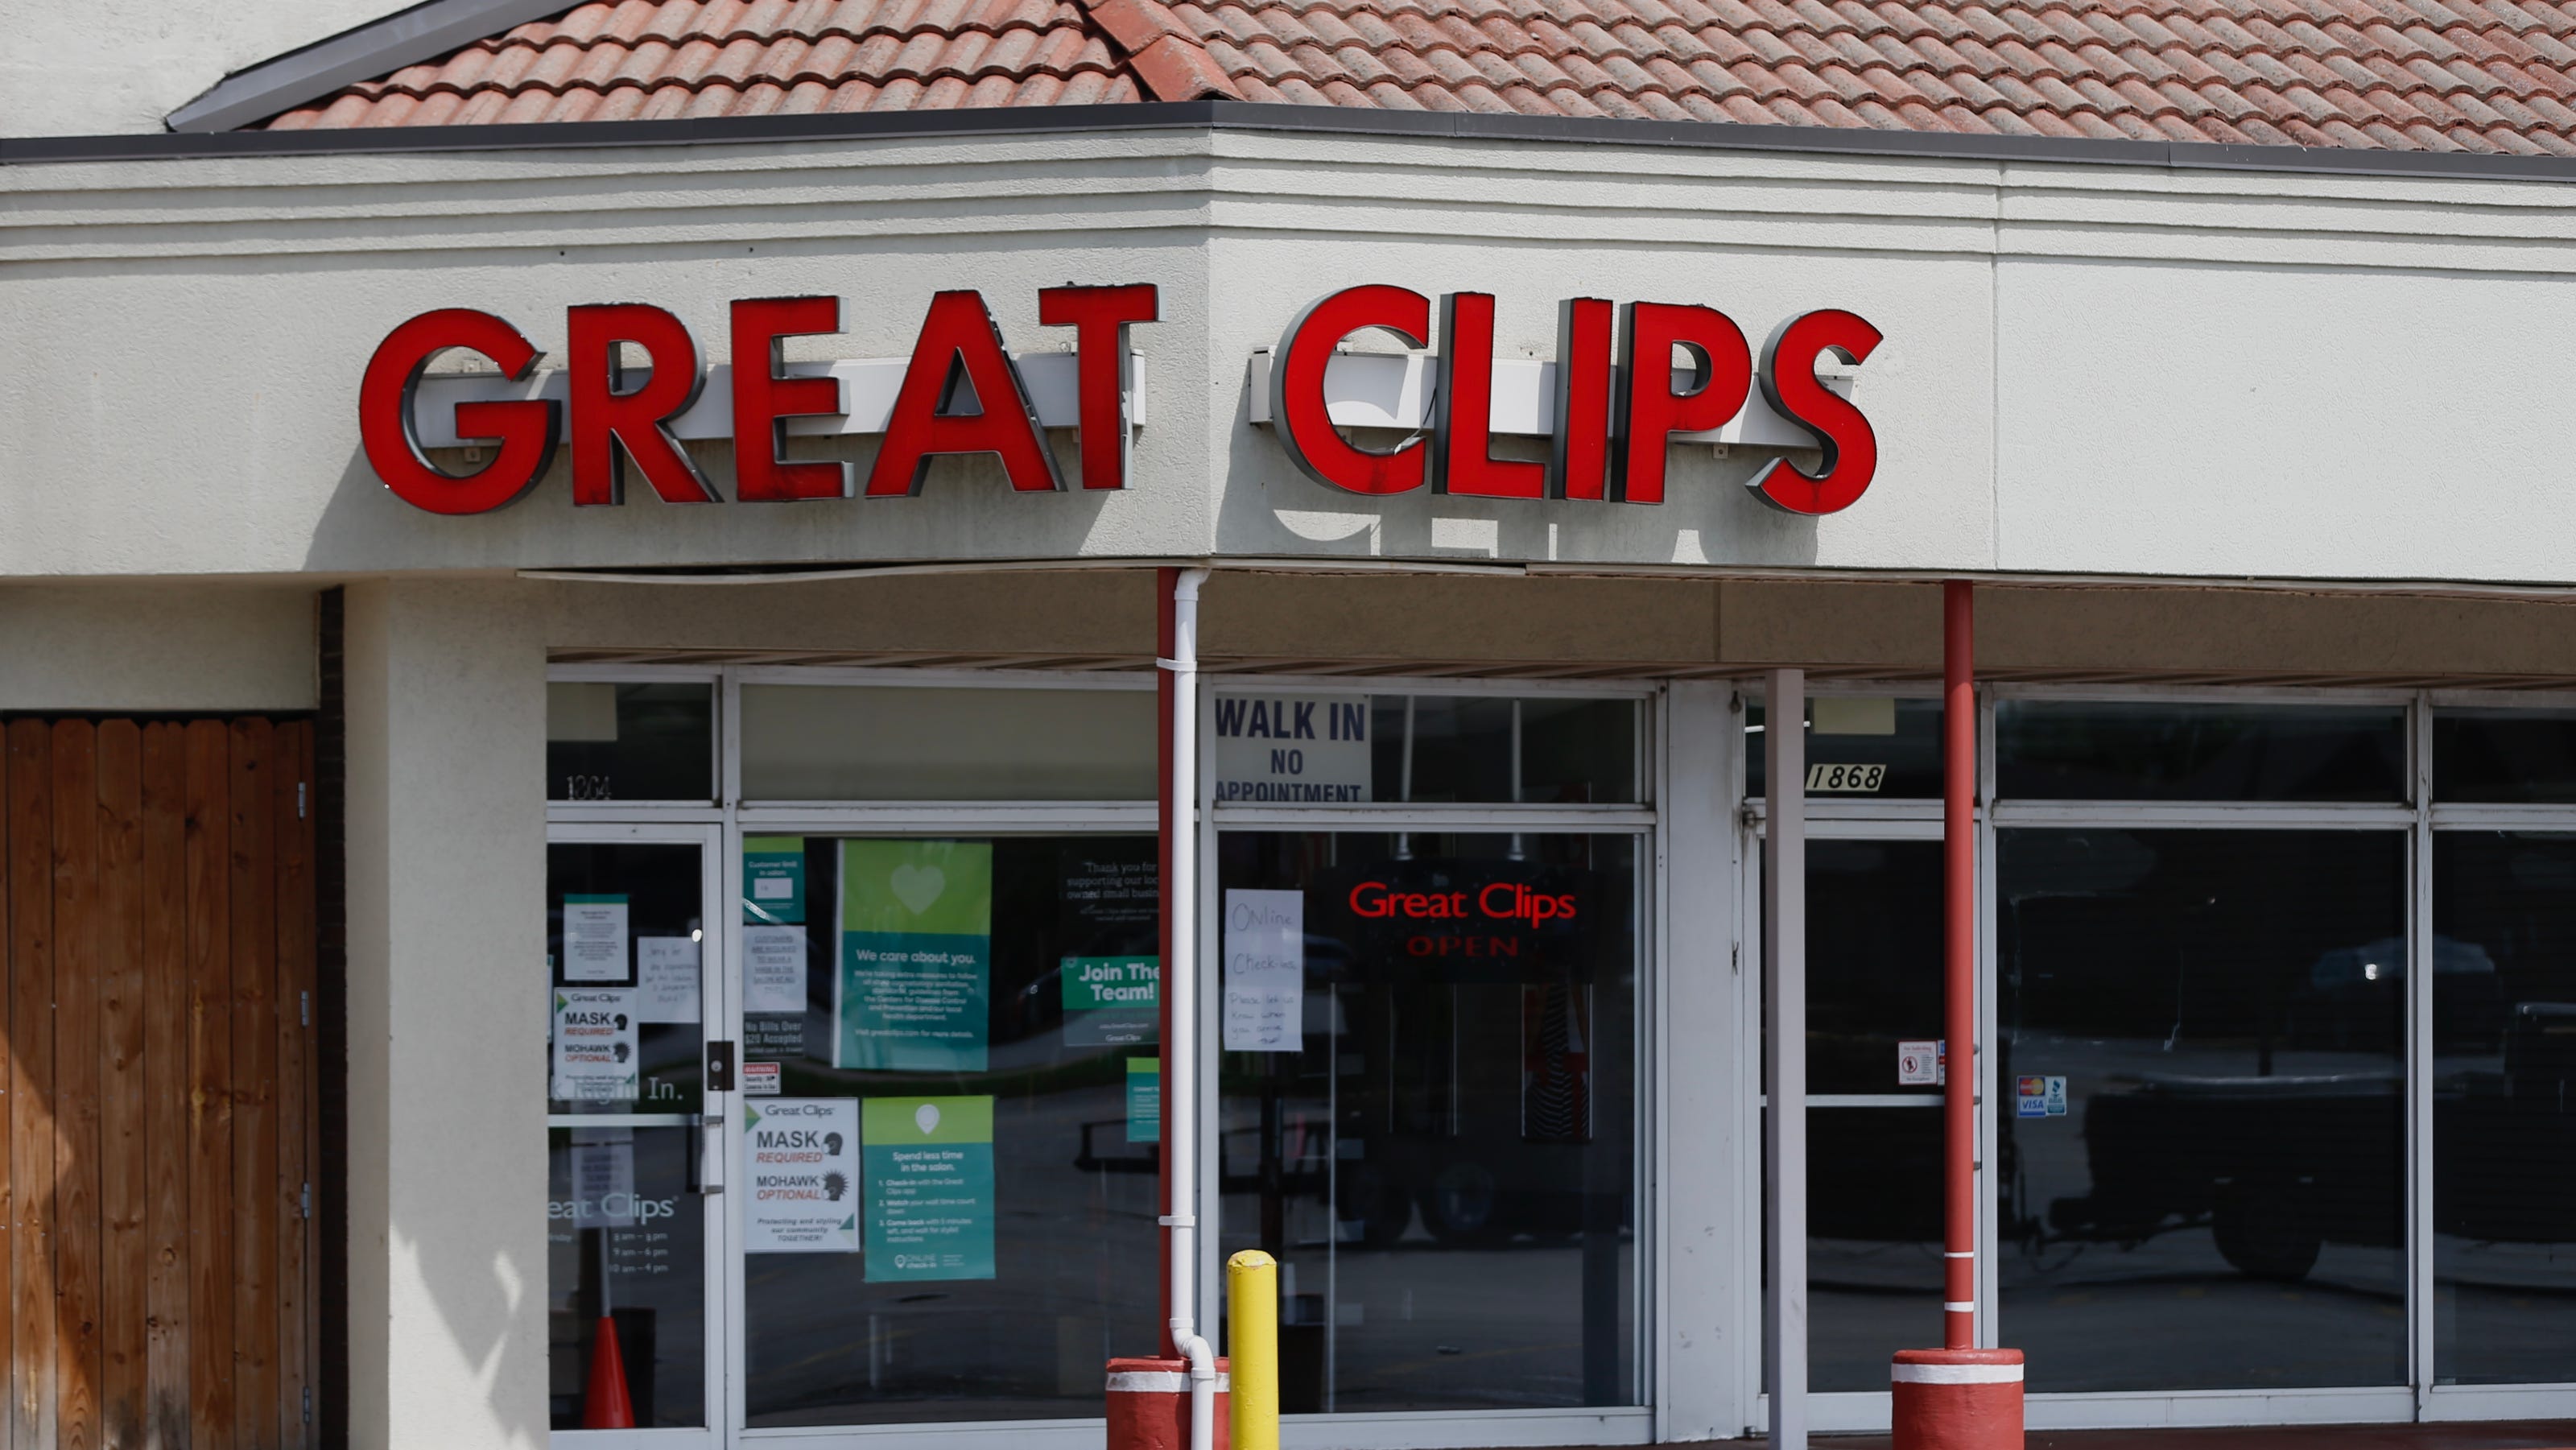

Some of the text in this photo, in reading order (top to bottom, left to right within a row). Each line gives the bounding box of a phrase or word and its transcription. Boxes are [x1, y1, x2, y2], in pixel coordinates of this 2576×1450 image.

[359, 283, 1884, 515] GREAT CLIPS
[1215, 699, 1364, 741] WALK IN
[1271, 749, 1303, 775] NO
[1813, 766, 1881, 788] 1868
[1216, 781, 1361, 802] APPOINTMENT
[1087, 861, 1157, 874] Thank you for
[1067, 876, 1123, 887] supporting
[1144, 874, 1159, 884] loc
[1067, 887, 1159, 899] owned small busin
[1350, 881, 1576, 929] Great Clips
[1406, 936, 1518, 956] OPEN
[856, 949, 976, 966] We care about you.
[1079, 963, 1159, 981] Join The
[571, 993, 621, 1003] Great Clips
[1091, 983, 1154, 1001] Team!
[565, 1012, 610, 1025] MASK
[565, 1027, 614, 1035] REQUIRED
[781, 1020, 802, 1031] Over
[763, 1033, 802, 1045] Accepted
[565, 1044, 611, 1052] MOHAWK
[565, 1054, 612, 1063] OPTIONAL
[648, 1076, 683, 1101] In.
[2022, 1098, 2044, 1109] VISA
[766, 1105, 833, 1118] Great Clips
[757, 1130, 819, 1148] MASK
[757, 1152, 823, 1163] REQUIRED
[893, 1150, 964, 1162] Spend less time
[901, 1163, 910, 1171] in
[911, 1163, 927, 1171] the
[757, 1176, 819, 1187] MOHAWK
[757, 1190, 819, 1200] OPTIONAL
[549, 1192, 675, 1226] eat Clips
[758, 1217, 797, 1225] Protecting
[815, 1217, 842, 1225] styling
